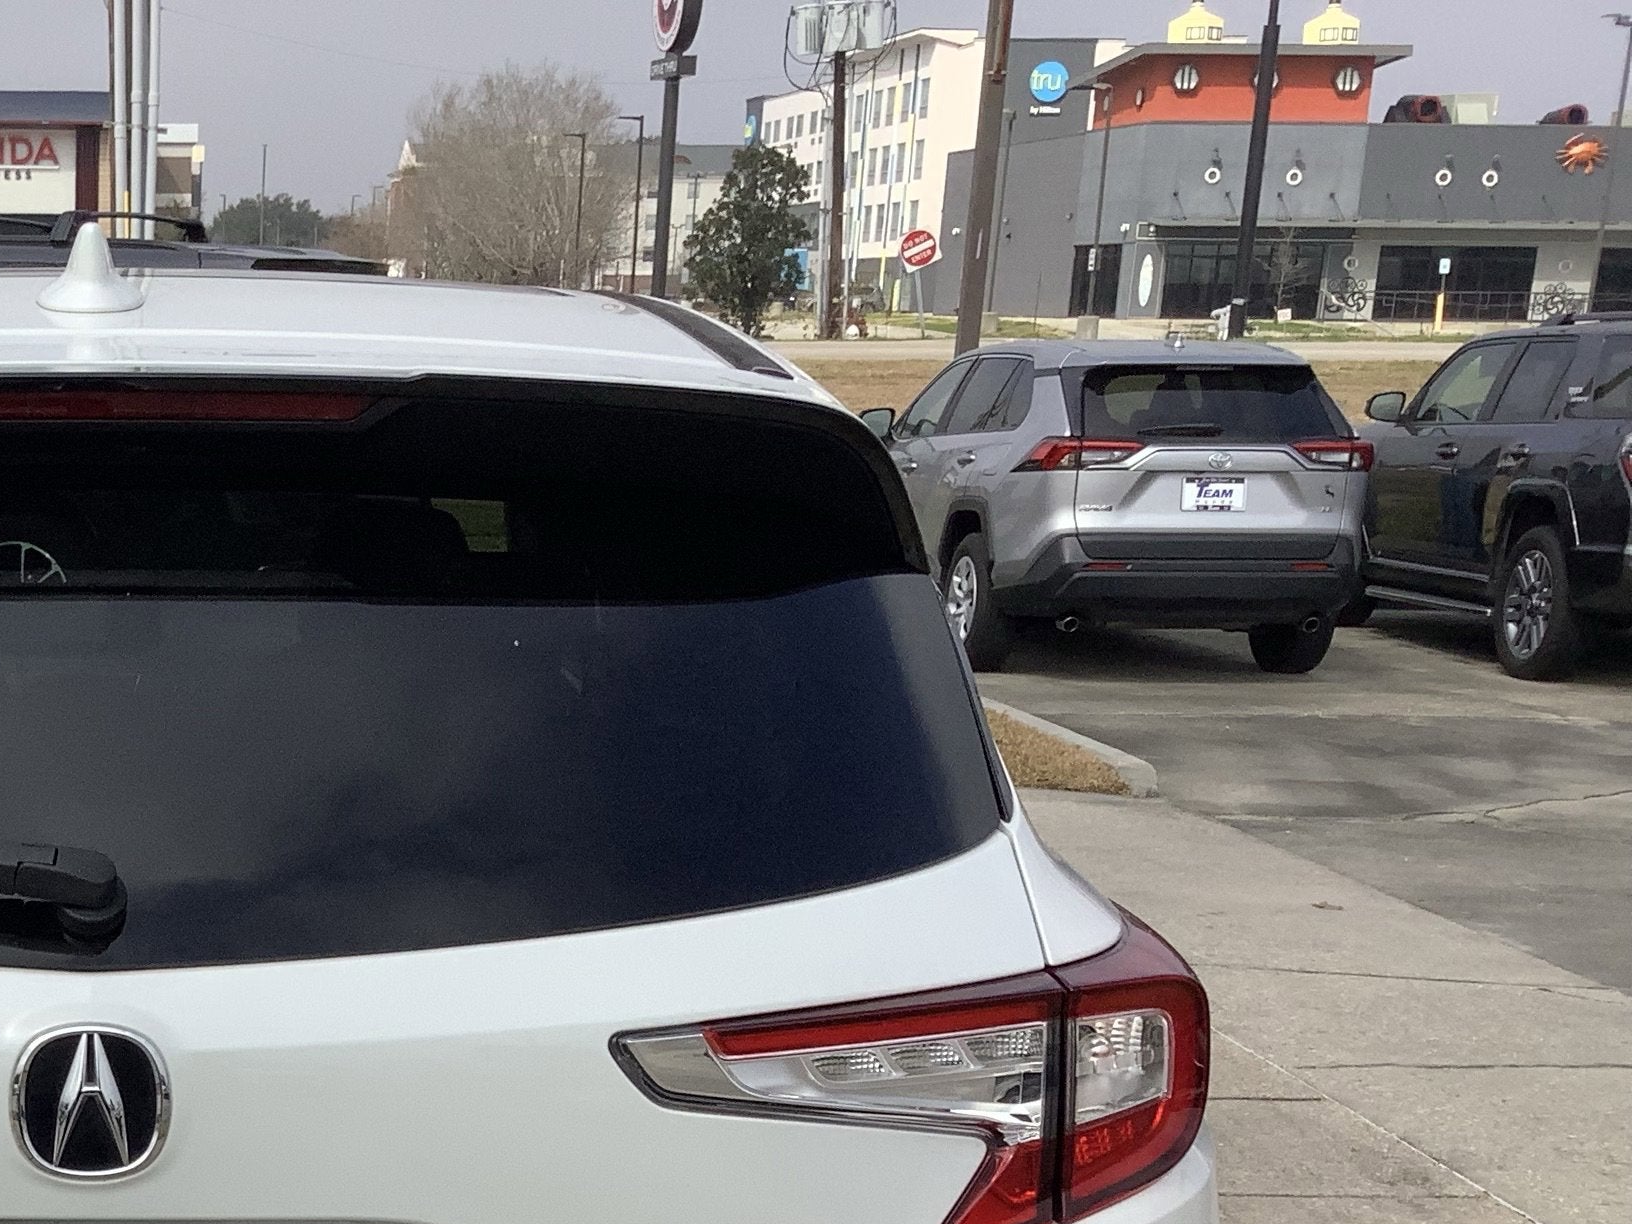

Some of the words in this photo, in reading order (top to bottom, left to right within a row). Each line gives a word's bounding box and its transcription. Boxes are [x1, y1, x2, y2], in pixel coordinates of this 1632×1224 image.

[1030, 69, 1062, 90] tru
[902, 239, 914, 250] DO
[914, 232, 929, 244] NOT
[910, 248, 932, 264] ENTER
[1196, 480, 1233, 498] TEAM
